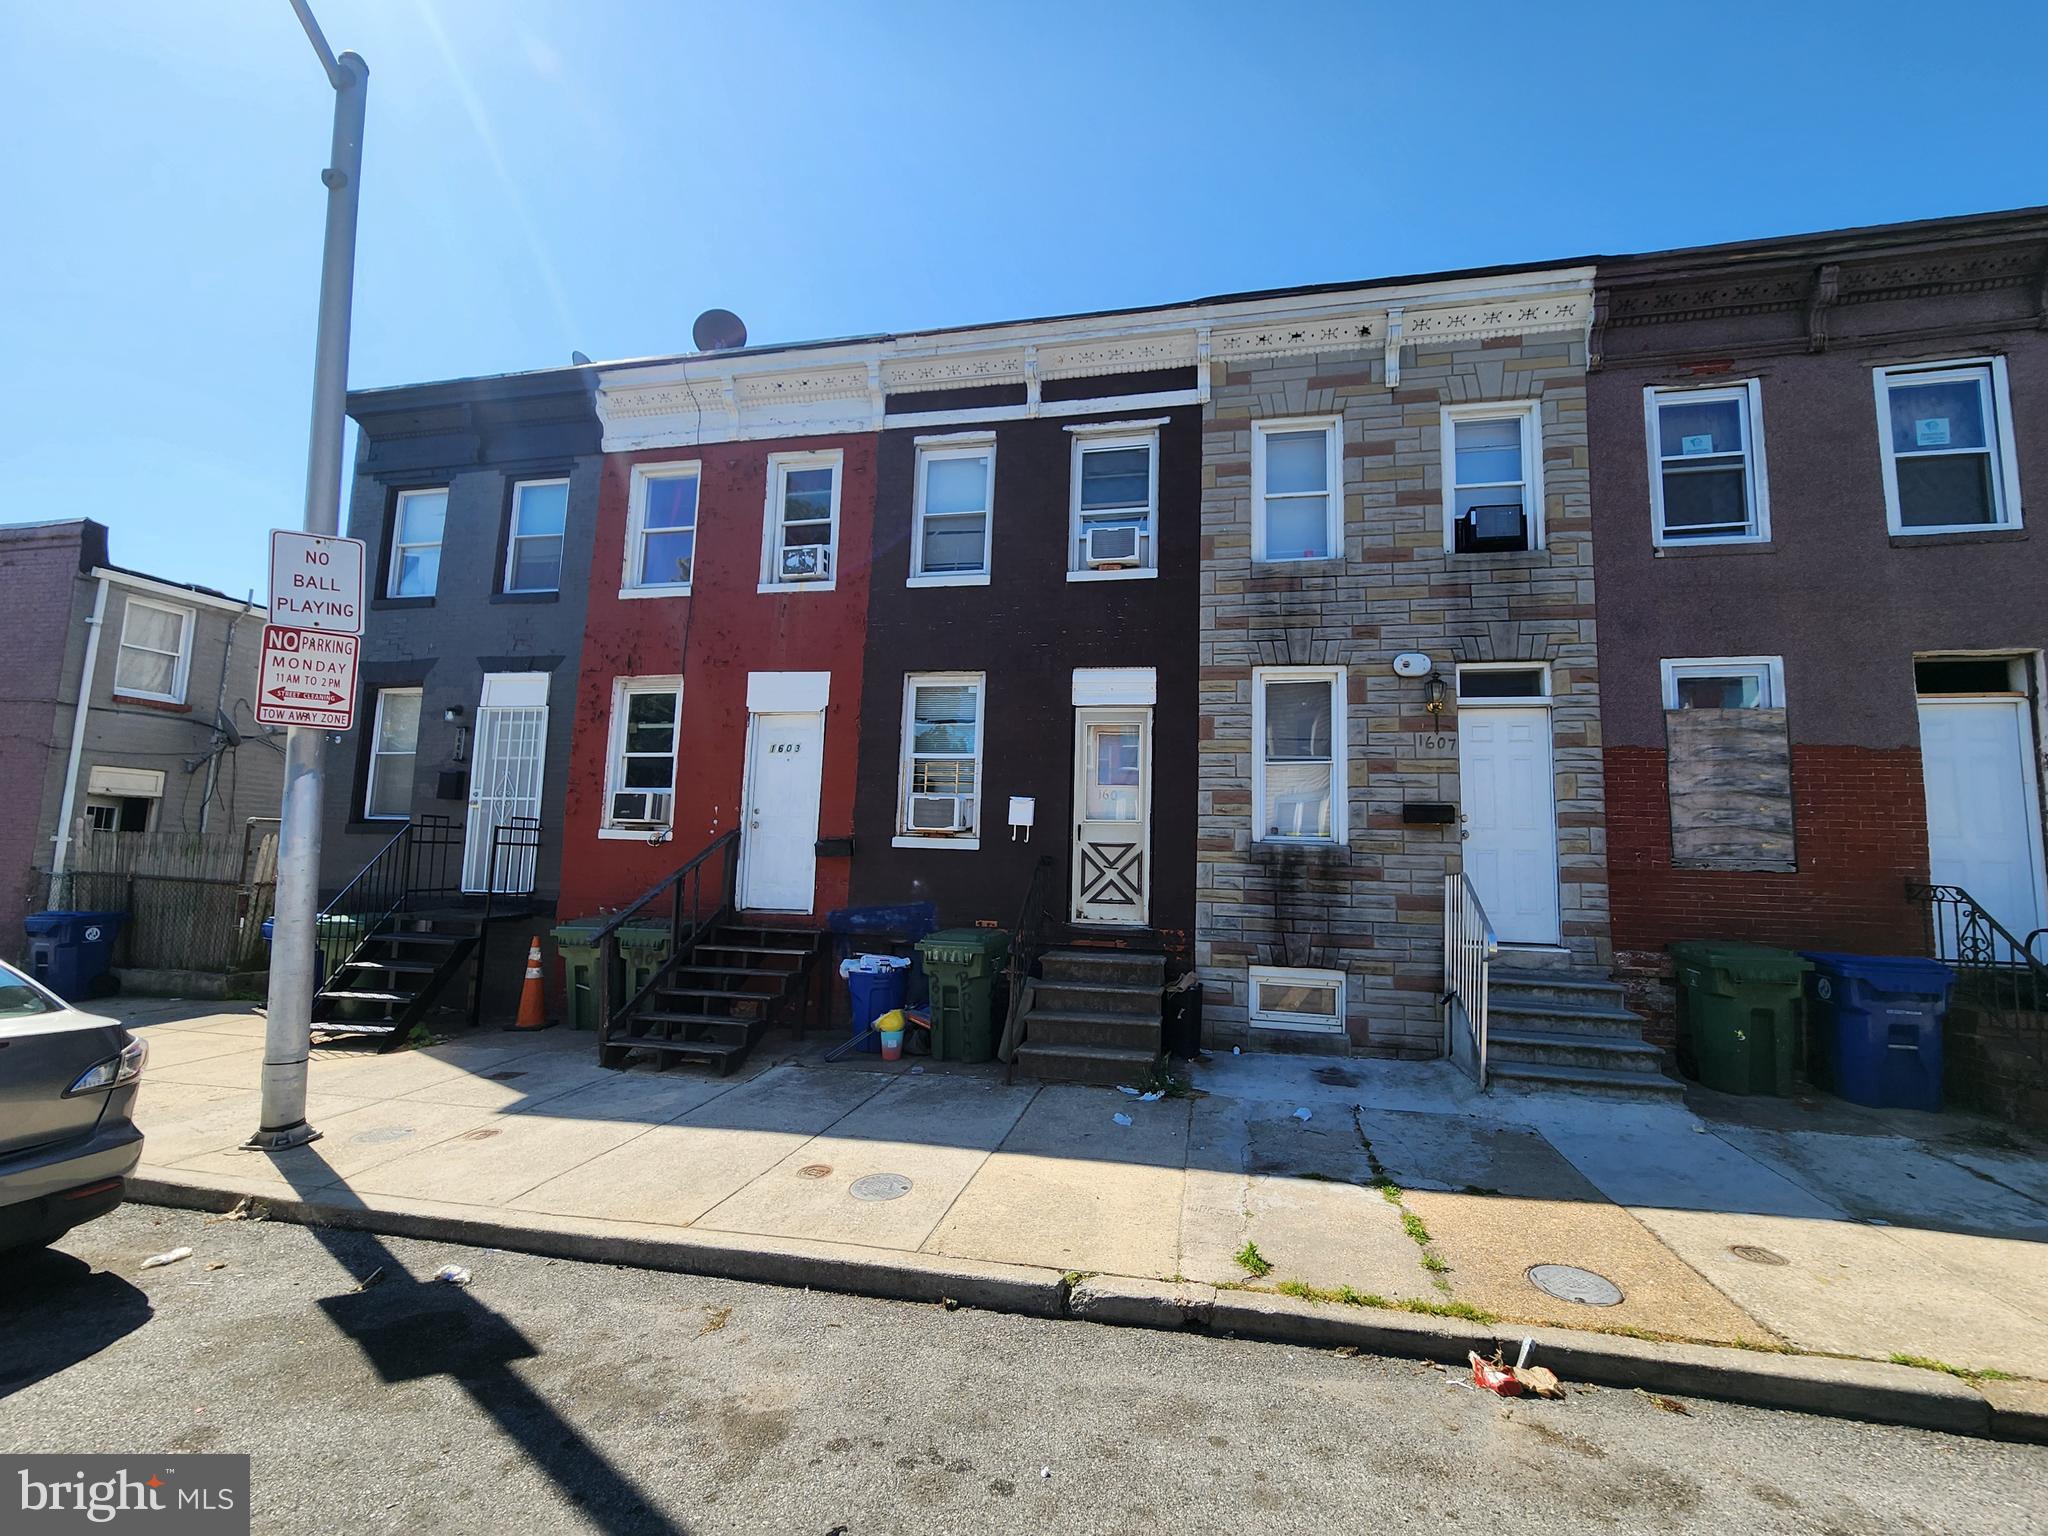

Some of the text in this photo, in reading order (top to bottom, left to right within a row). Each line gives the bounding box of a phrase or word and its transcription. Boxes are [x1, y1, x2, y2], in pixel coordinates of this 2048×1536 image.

[305, 550, 330, 566] NO
[293, 574, 341, 592] BALL
[277, 597, 354, 617] PLAYING
[268, 630, 353, 655] NO PARKING
[272, 655, 346, 674] MONDAY
[304, 675, 318, 686] TO
[277, 690, 336, 702] STREET CLEANING
[263, 708, 347, 725] TOW AWAY ZONE
[770, 743, 801, 754] 1603
[1418, 734, 1457, 751] 1607
